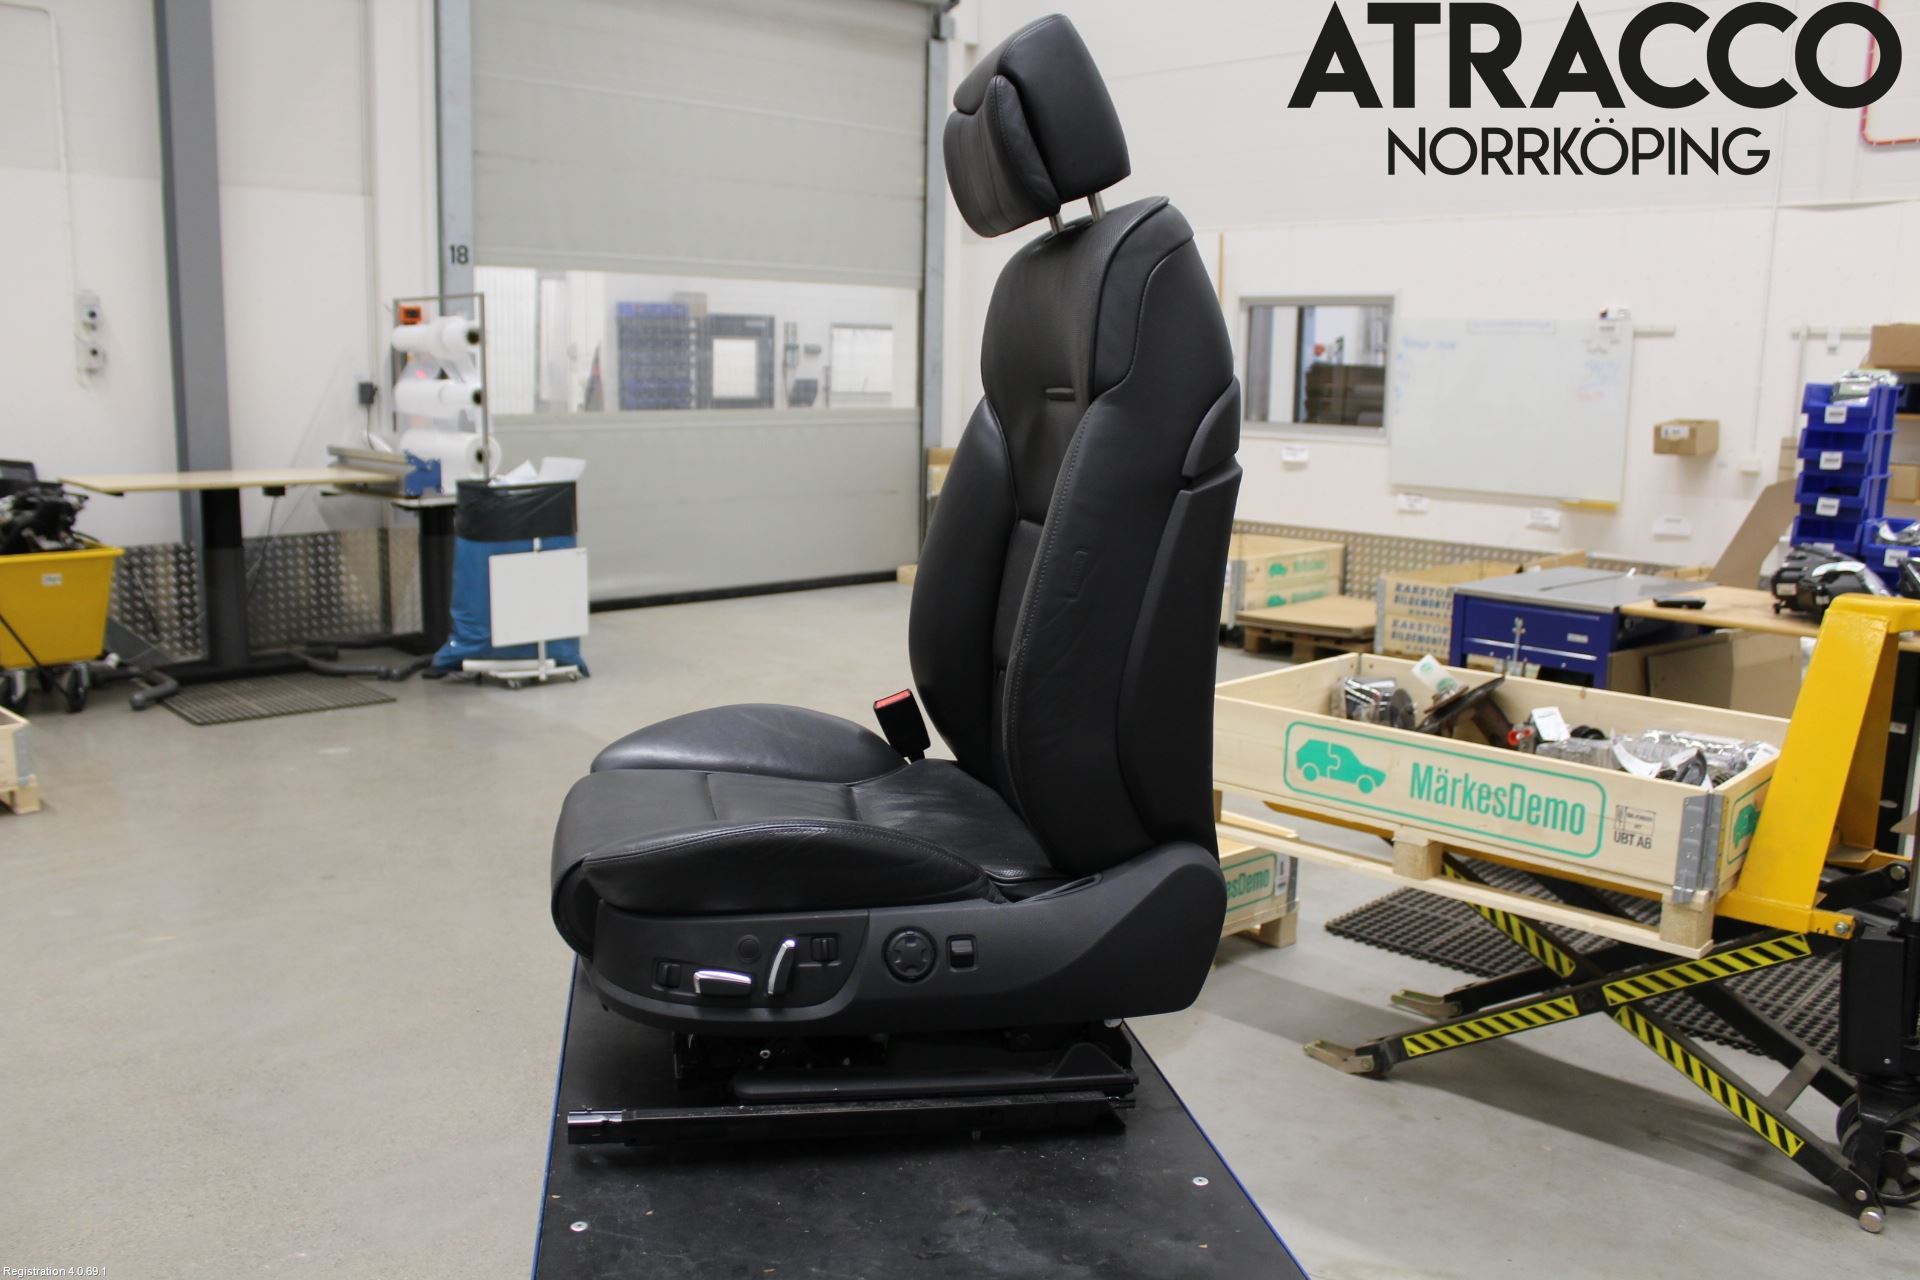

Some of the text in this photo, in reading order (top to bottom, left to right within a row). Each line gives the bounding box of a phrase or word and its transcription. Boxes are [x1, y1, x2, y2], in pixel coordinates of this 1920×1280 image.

[450, 244, 469, 265] 18
[1410, 762, 1587, 836] MärkesDemo
[1614, 831, 1652, 849] UBT AB
